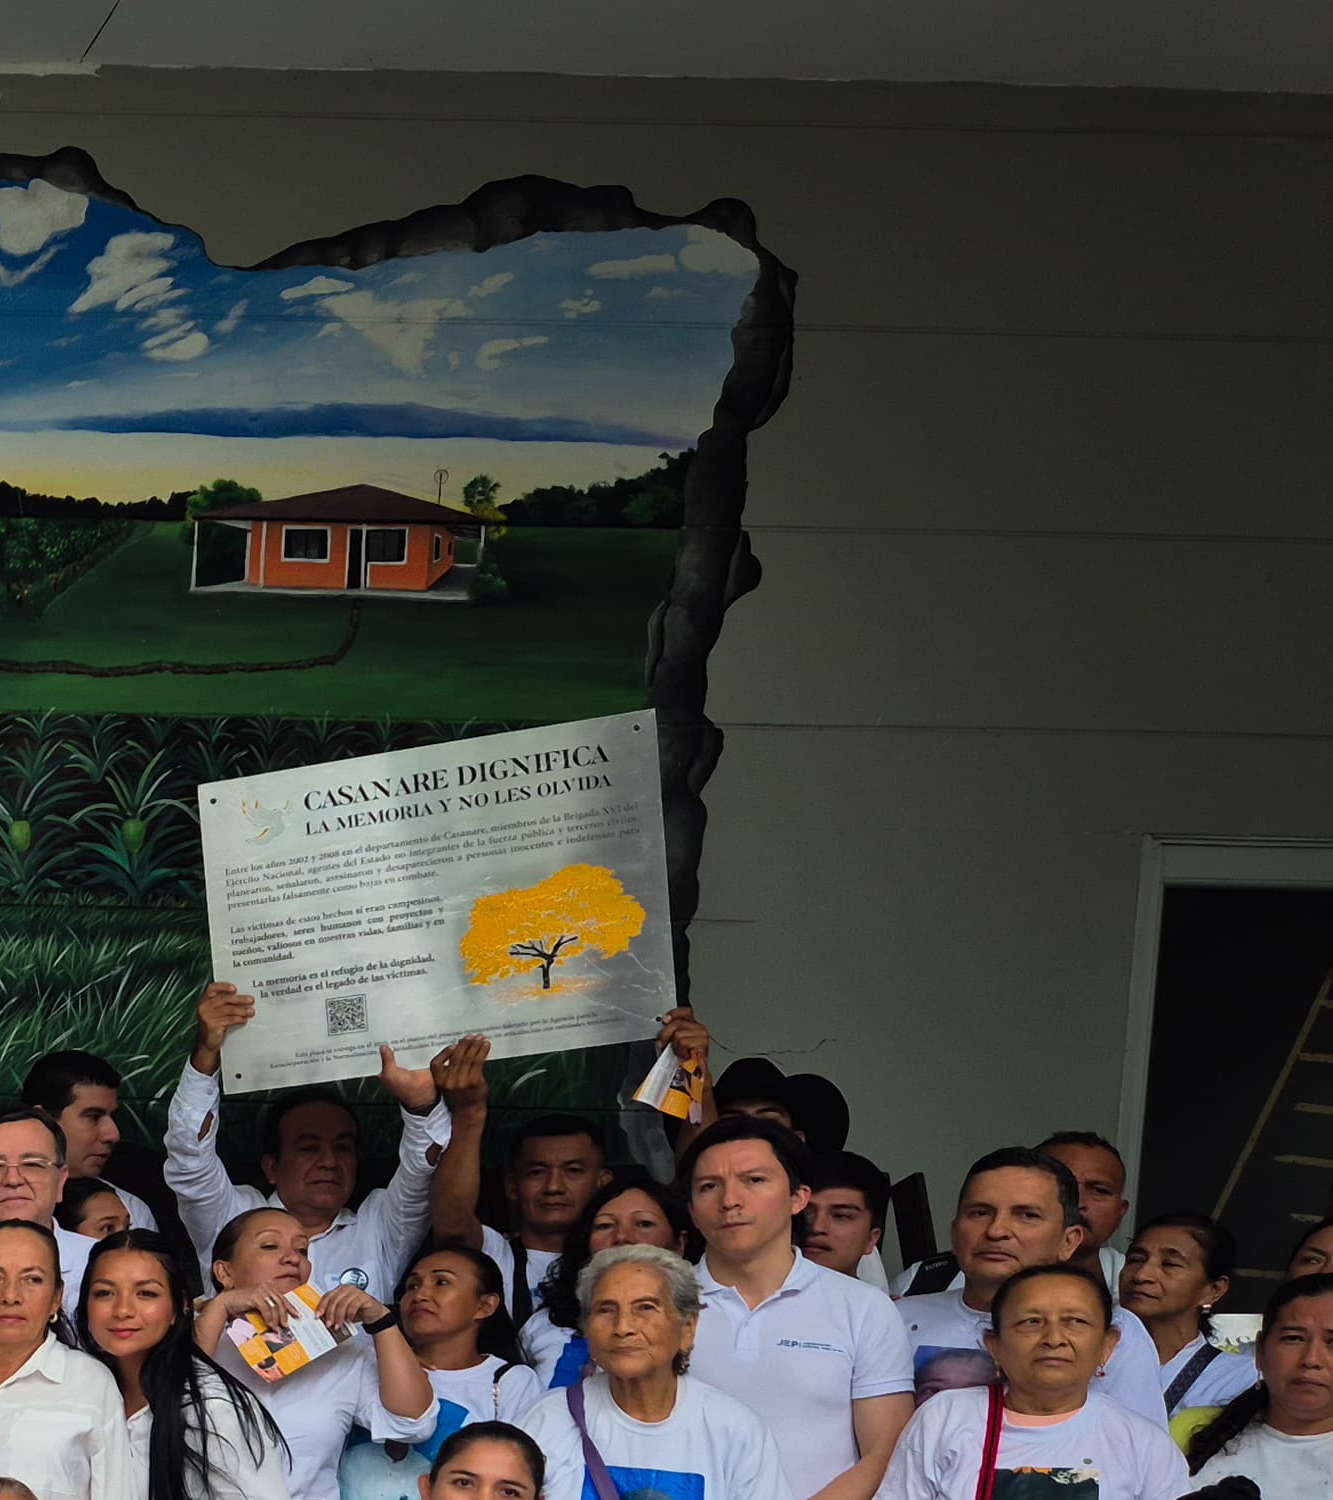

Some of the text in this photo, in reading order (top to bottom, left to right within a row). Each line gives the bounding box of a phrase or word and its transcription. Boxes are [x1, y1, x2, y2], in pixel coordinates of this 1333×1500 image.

[303, 741, 609, 812] CASANARE DIGNIFICA
[305, 771, 611, 835] LA MEMORIA Y NO LES OLVIDA
[776, 1339, 799, 1348] JEP
